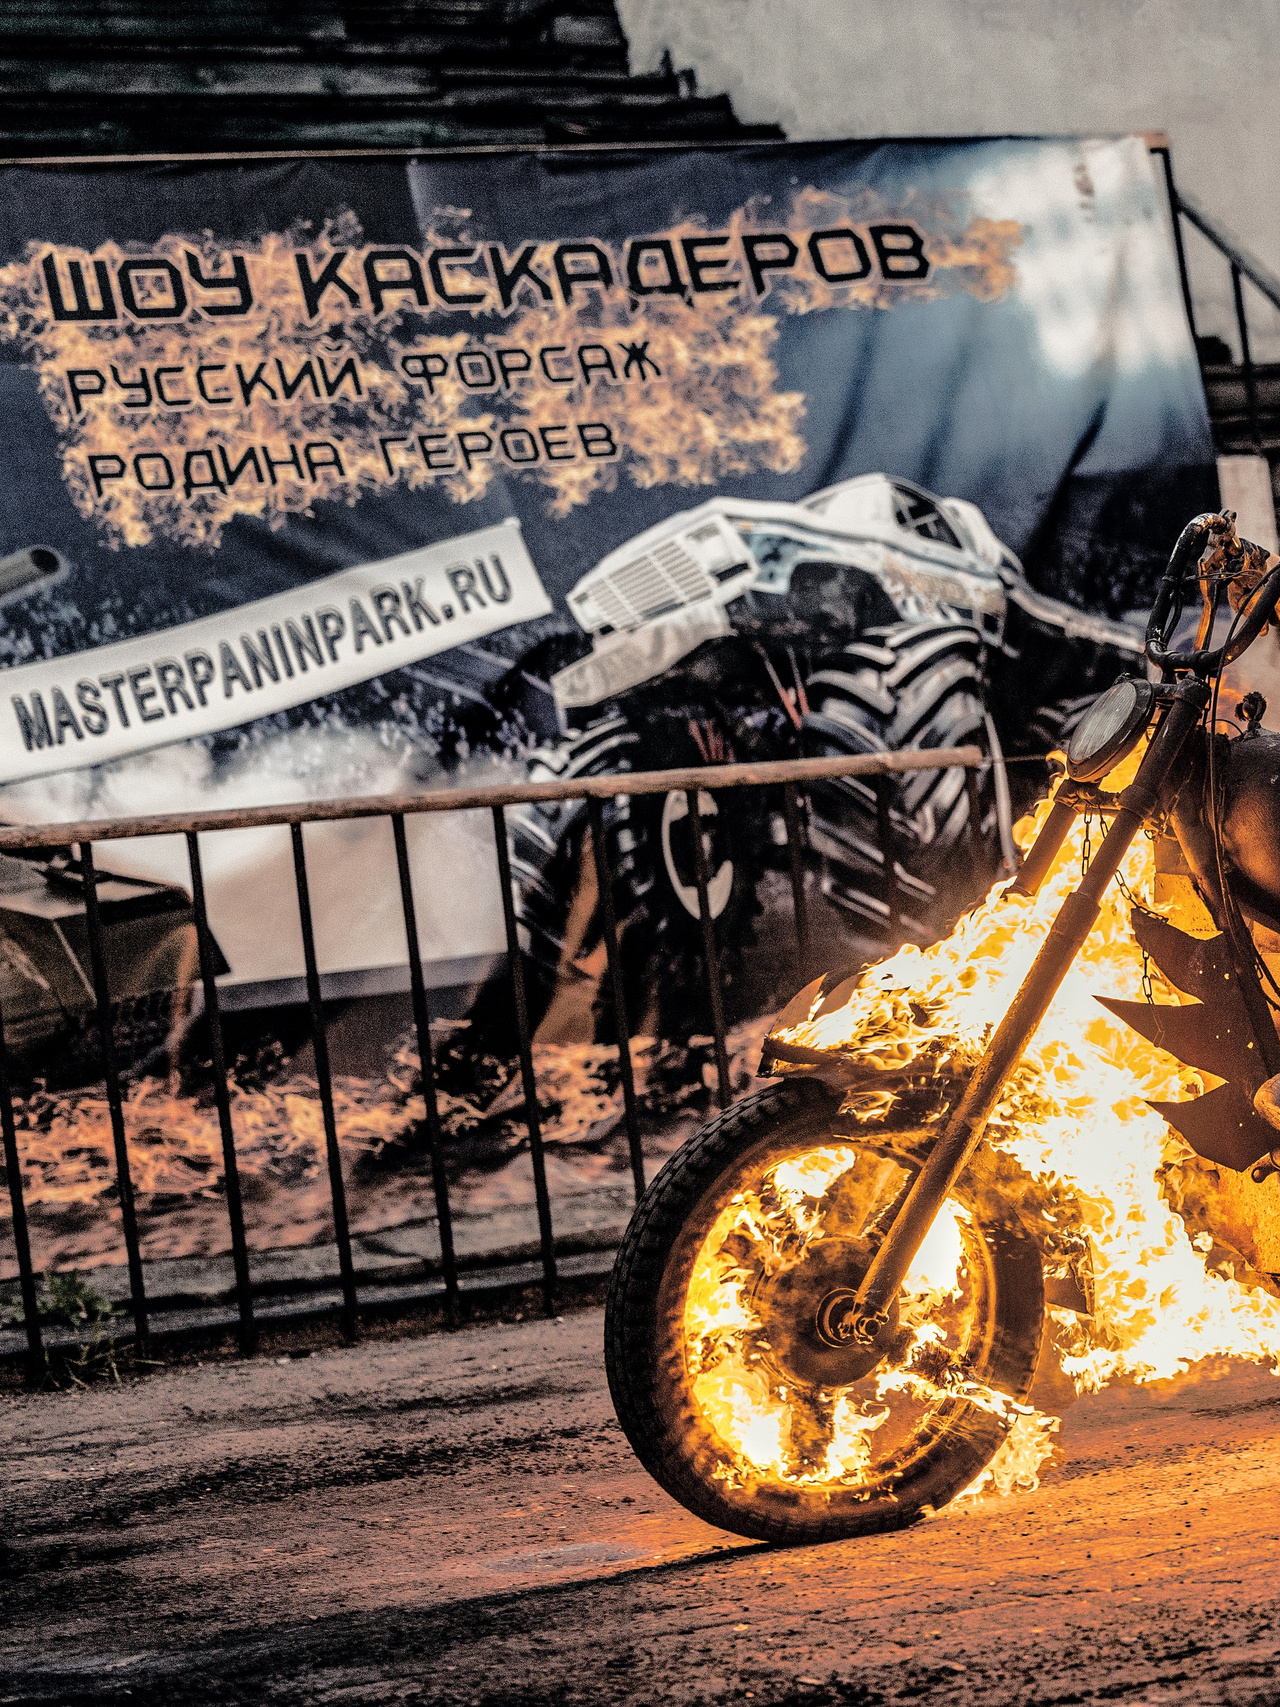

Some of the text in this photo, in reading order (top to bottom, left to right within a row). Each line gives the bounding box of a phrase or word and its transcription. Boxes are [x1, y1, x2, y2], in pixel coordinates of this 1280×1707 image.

[41, 224, 930, 322] ШОУ КАСКАДЕРОВ
[66, 340, 662, 414] РУССКИЙ ФОРСАЖ
[88, 422, 617, 498] РОДИНА ГЕРОЕВ
[14, 553, 514, 752] MASTERPANINPARK.RU
